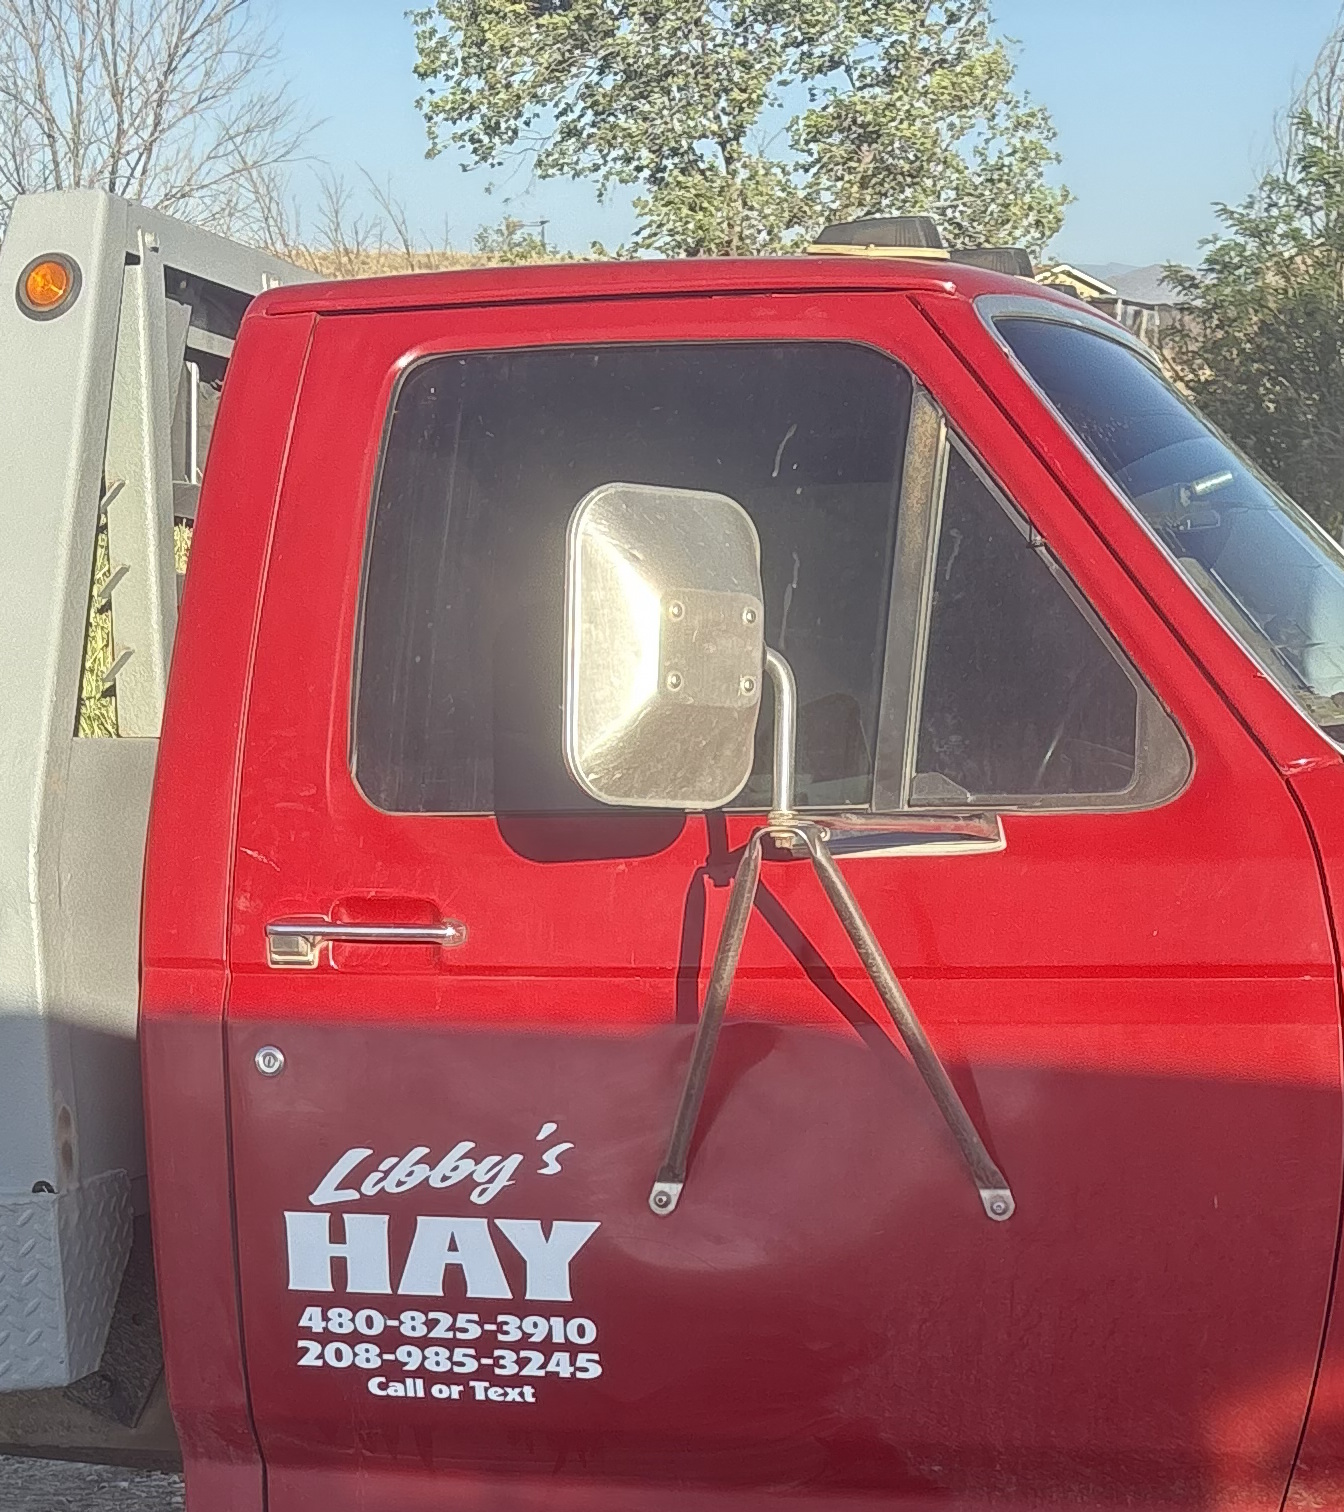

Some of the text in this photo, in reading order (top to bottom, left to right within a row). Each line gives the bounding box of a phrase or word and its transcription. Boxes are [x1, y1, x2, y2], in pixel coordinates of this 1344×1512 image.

[308, 1122, 575, 1206] Libby's
[283, 1210, 602, 1302] HAY
[297, 1306, 597, 1345] 480-825-3910
[297, 1339, 603, 1379] 208-985-3245
[367, 1376, 536, 1403] Call or Text
